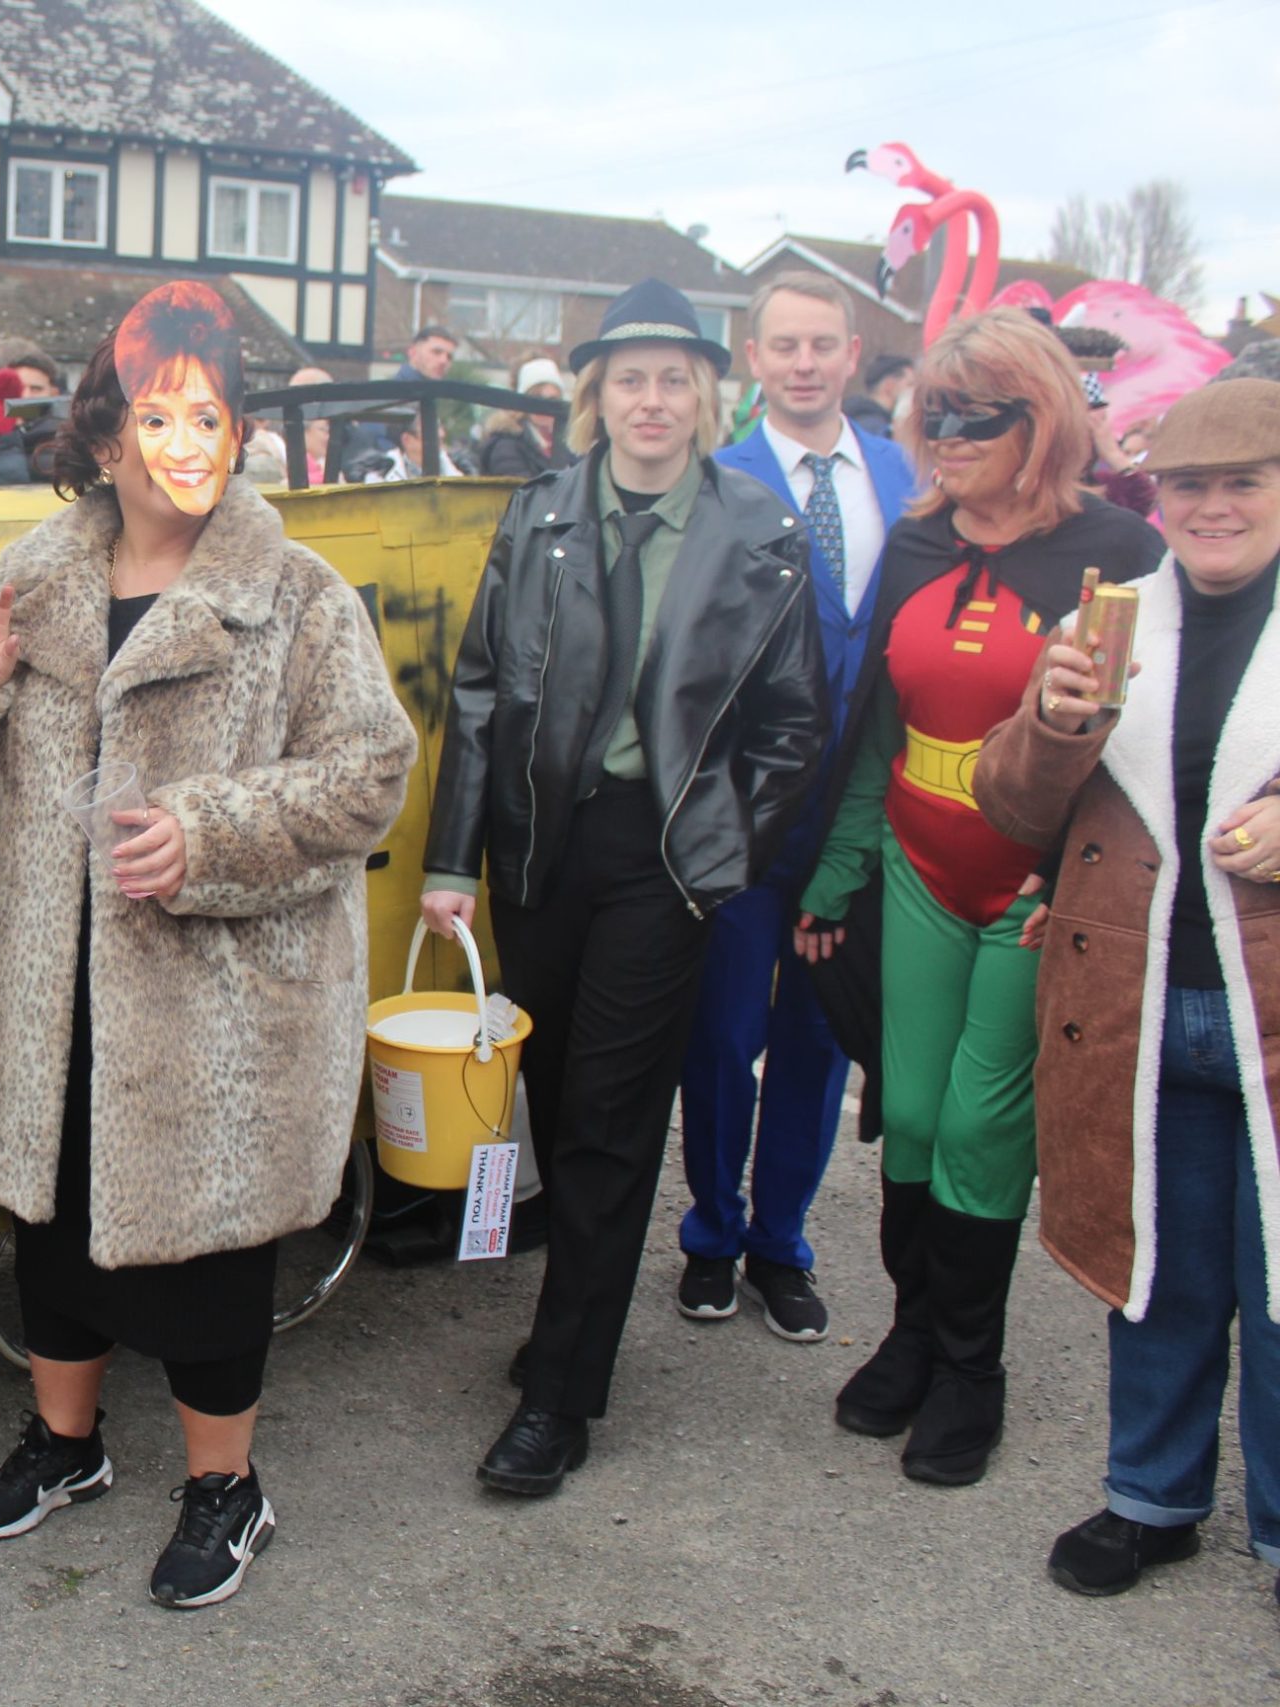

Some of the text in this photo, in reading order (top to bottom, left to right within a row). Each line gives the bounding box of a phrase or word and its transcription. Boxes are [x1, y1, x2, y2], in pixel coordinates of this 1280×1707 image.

[471, 1148, 489, 1224] THANK YOU
[496, 1149, 516, 1253] PAGHAM PRAM RACE
